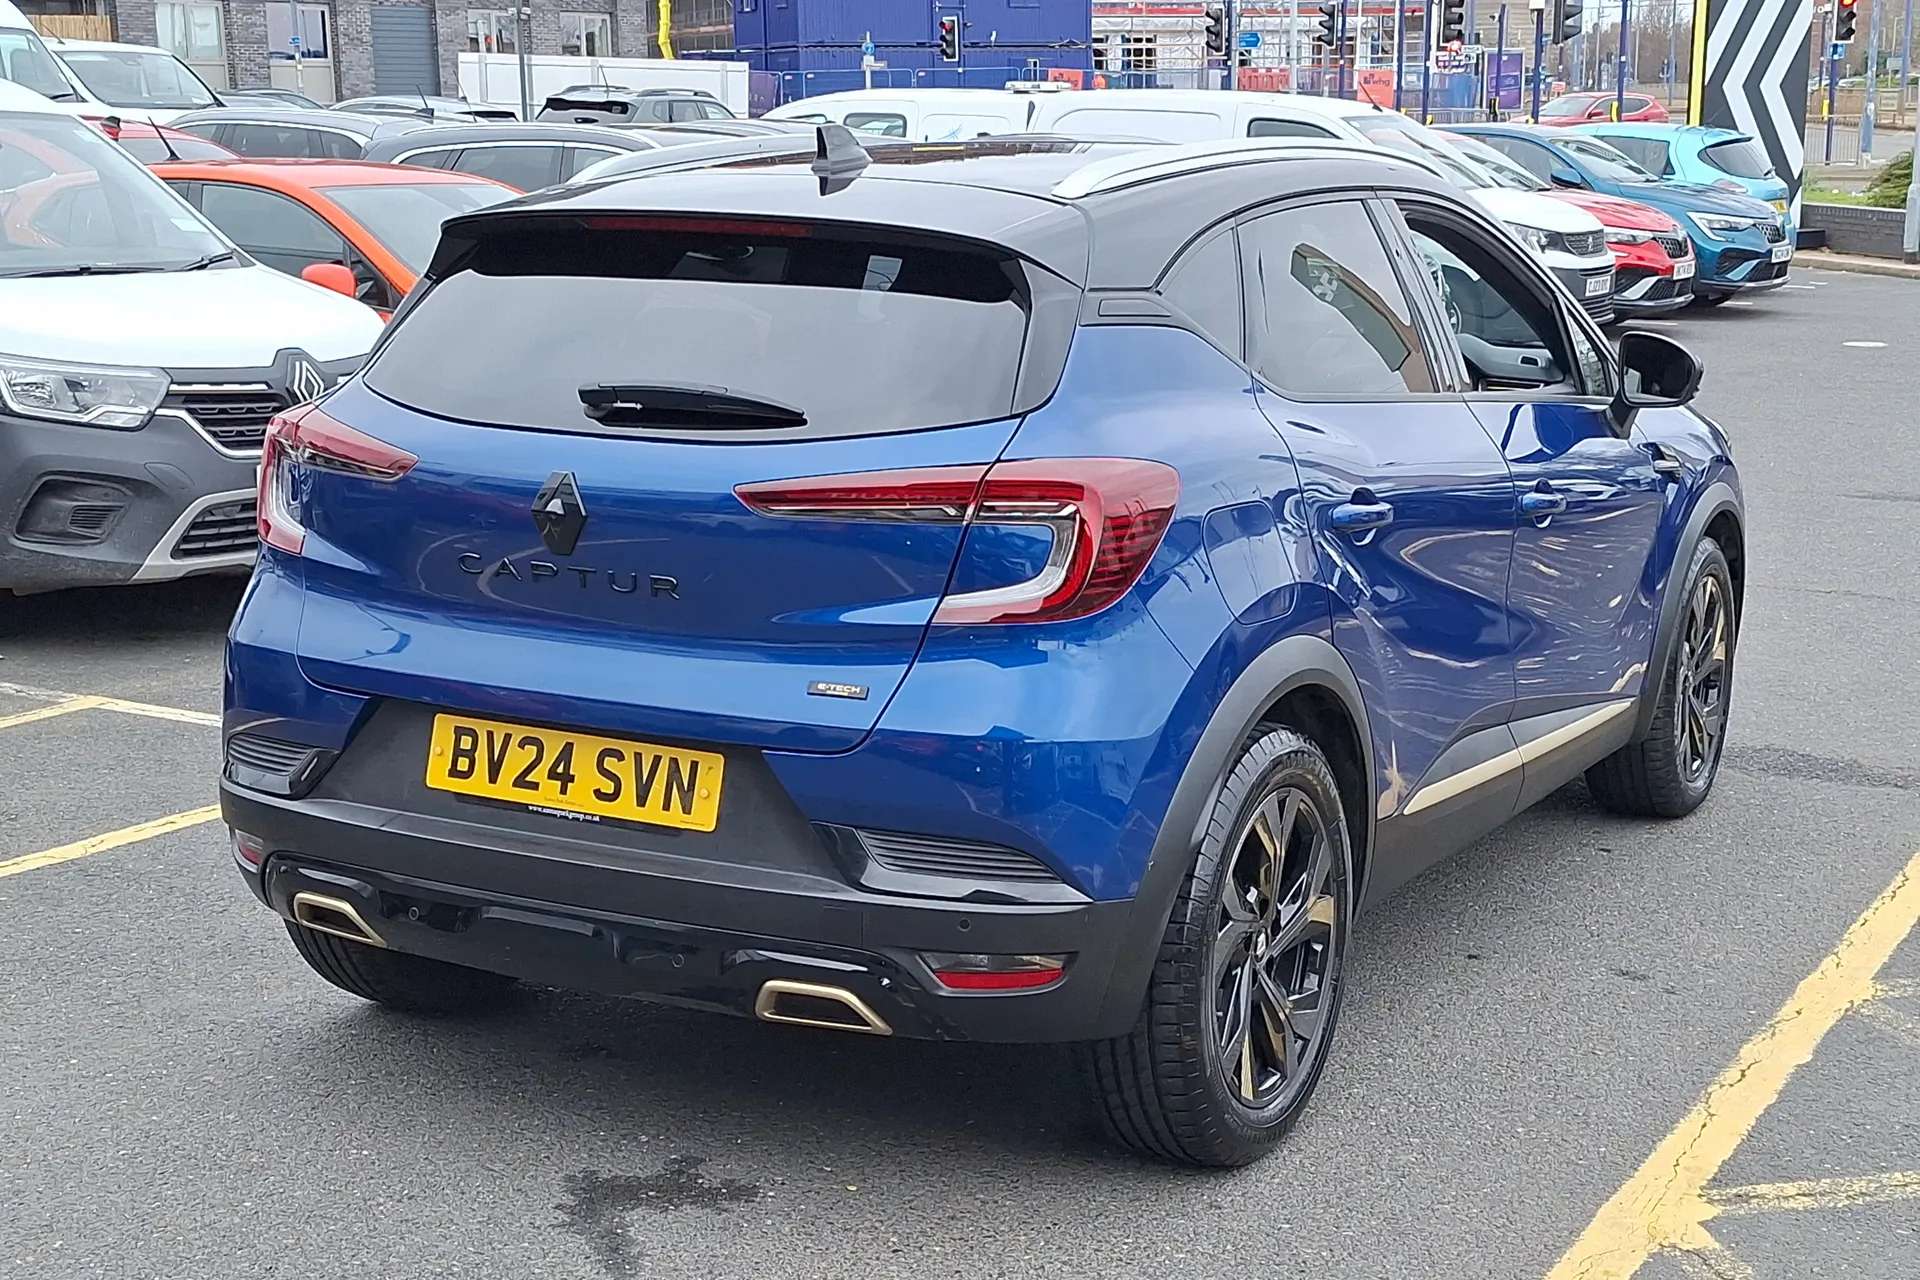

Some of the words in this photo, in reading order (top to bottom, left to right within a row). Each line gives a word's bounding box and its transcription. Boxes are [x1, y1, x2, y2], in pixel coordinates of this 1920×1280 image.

[457, 551, 680, 600] CAPTUR
[817, 683, 861, 694] E-TECH
[448, 725, 576, 796] BV24
[592, 747, 700, 815] SVN
